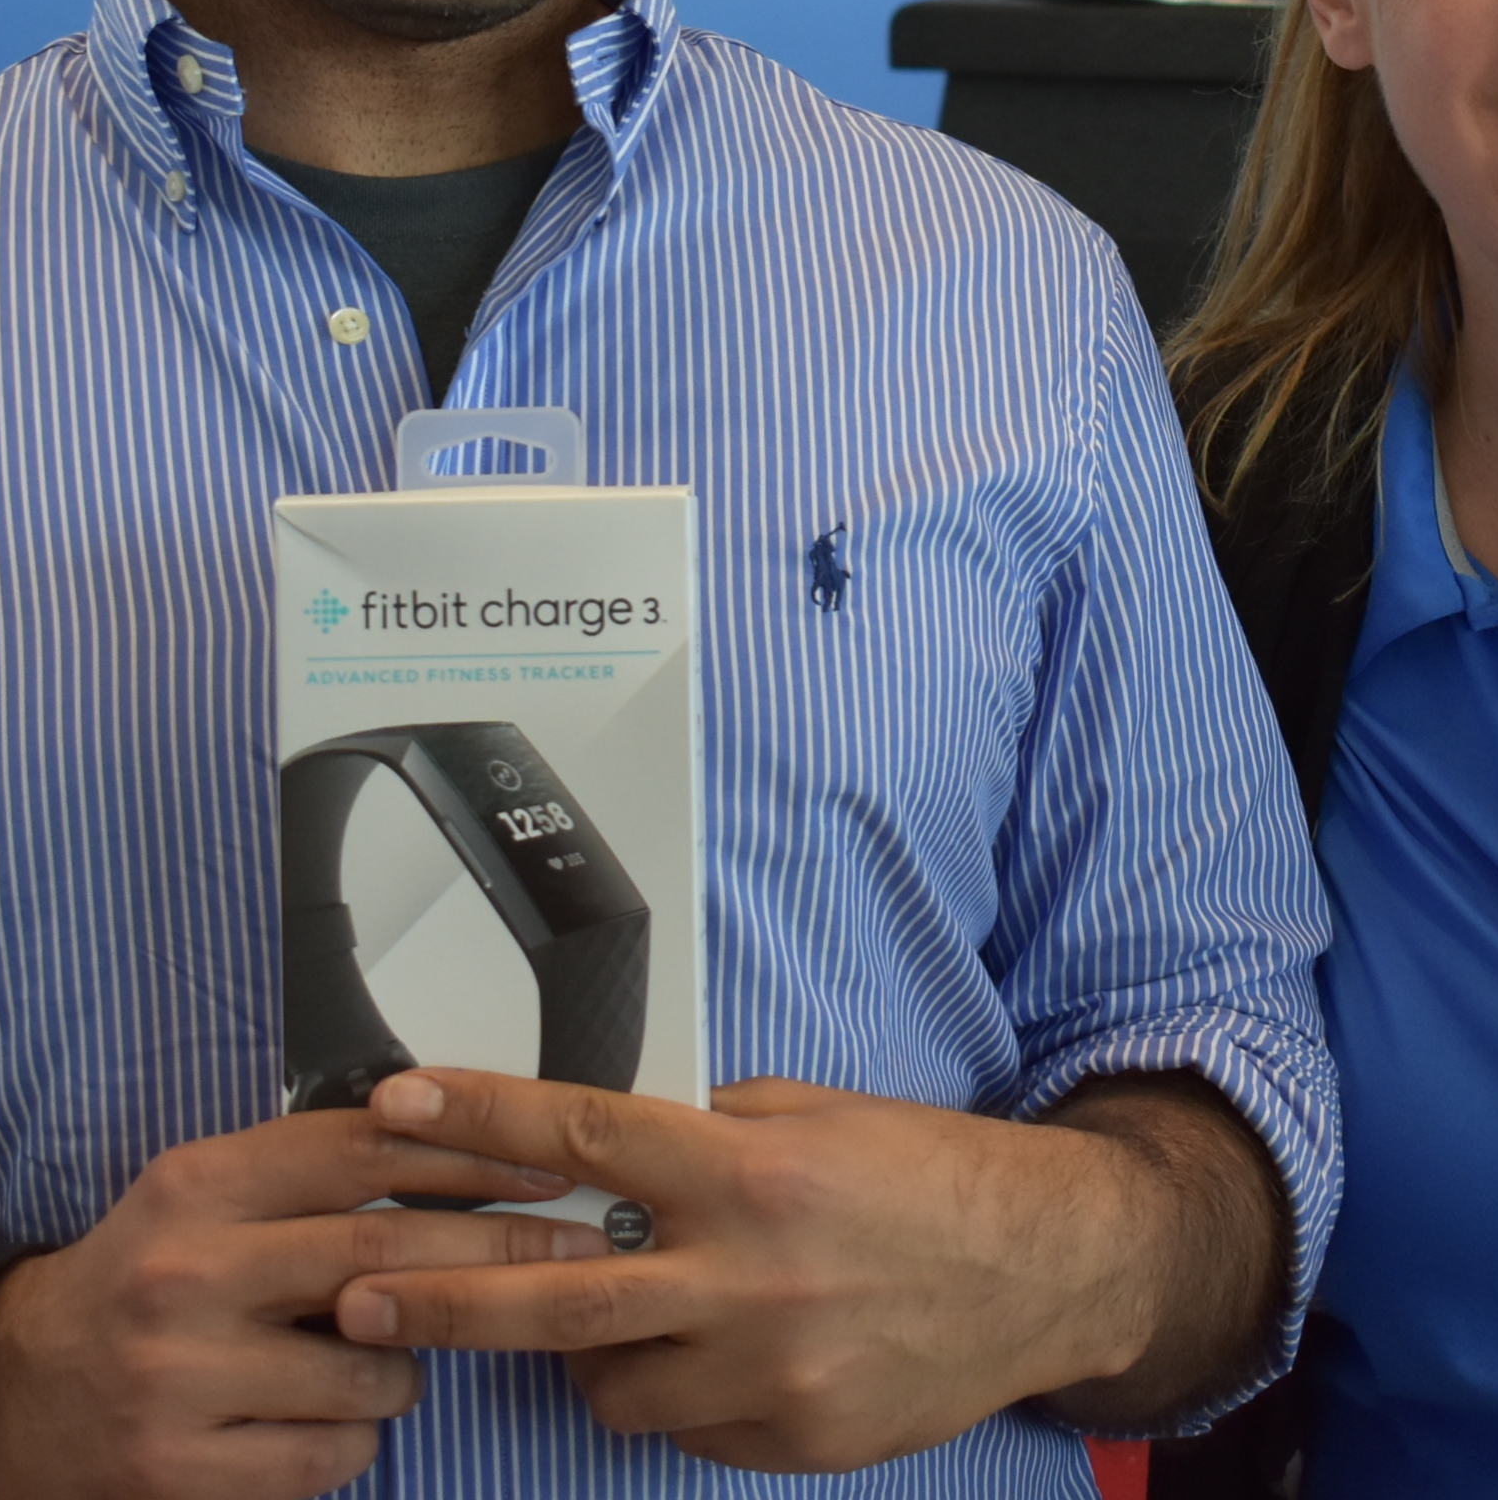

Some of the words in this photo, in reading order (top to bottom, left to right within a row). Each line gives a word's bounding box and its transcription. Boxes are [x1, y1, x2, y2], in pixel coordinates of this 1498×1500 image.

[361, 589, 468, 630] fitbit
[480, 587, 633, 637] charge
[305, 668, 420, 685] ADVANCED
[427, 666, 512, 683] FITNESS
[519, 664, 616, 681] TRACKER
[497, 801, 575, 841] 1258
[611, 1211, 644, 1219] SMALL
